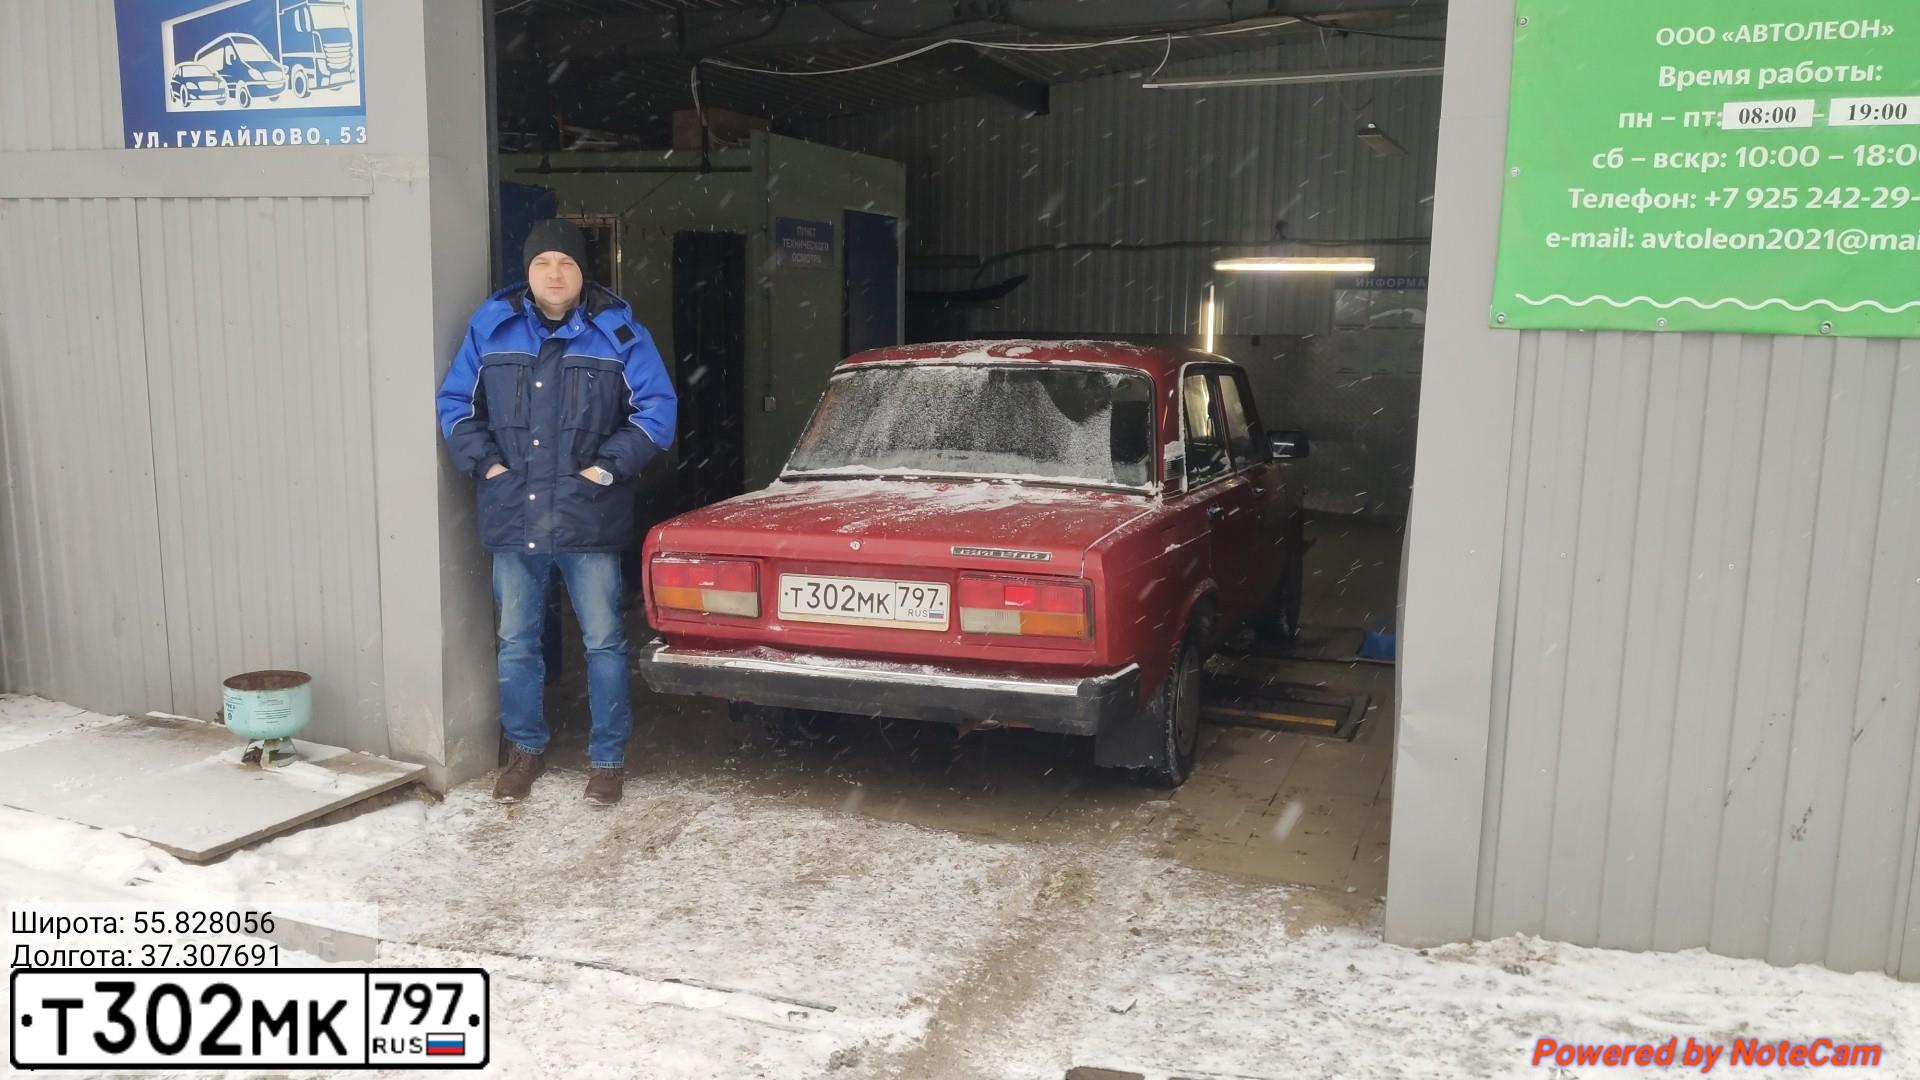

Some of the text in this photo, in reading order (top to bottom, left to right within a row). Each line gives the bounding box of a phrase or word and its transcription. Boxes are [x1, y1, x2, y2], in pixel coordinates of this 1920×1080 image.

[1655, 19, 1895, 46] ООО «АВТОЛЕОН»
[1658, 61, 1883, 91] Время работы:
[1618, 113, 1653, 128] пн
[1737, 105, 1797, 124] 08:00
[1848, 101, 1908, 121] 19:00
[133, 125, 367, 149] УЛ. ГУБАЙЛОВО, 53
[1592, 147, 1624, 168] сб
[1653, 151, 1727, 172] вскр:
[1735, 145, 1820, 168] 10:00
[1853, 143, 1920, 166] 18:0
[1568, 187, 1920, 213] Телефон: +7 925 242-29-
[1546, 228, 1635, 249] e-mail:
[898, 586, 938, 608] 797
[908, 608, 928, 618] RUS
